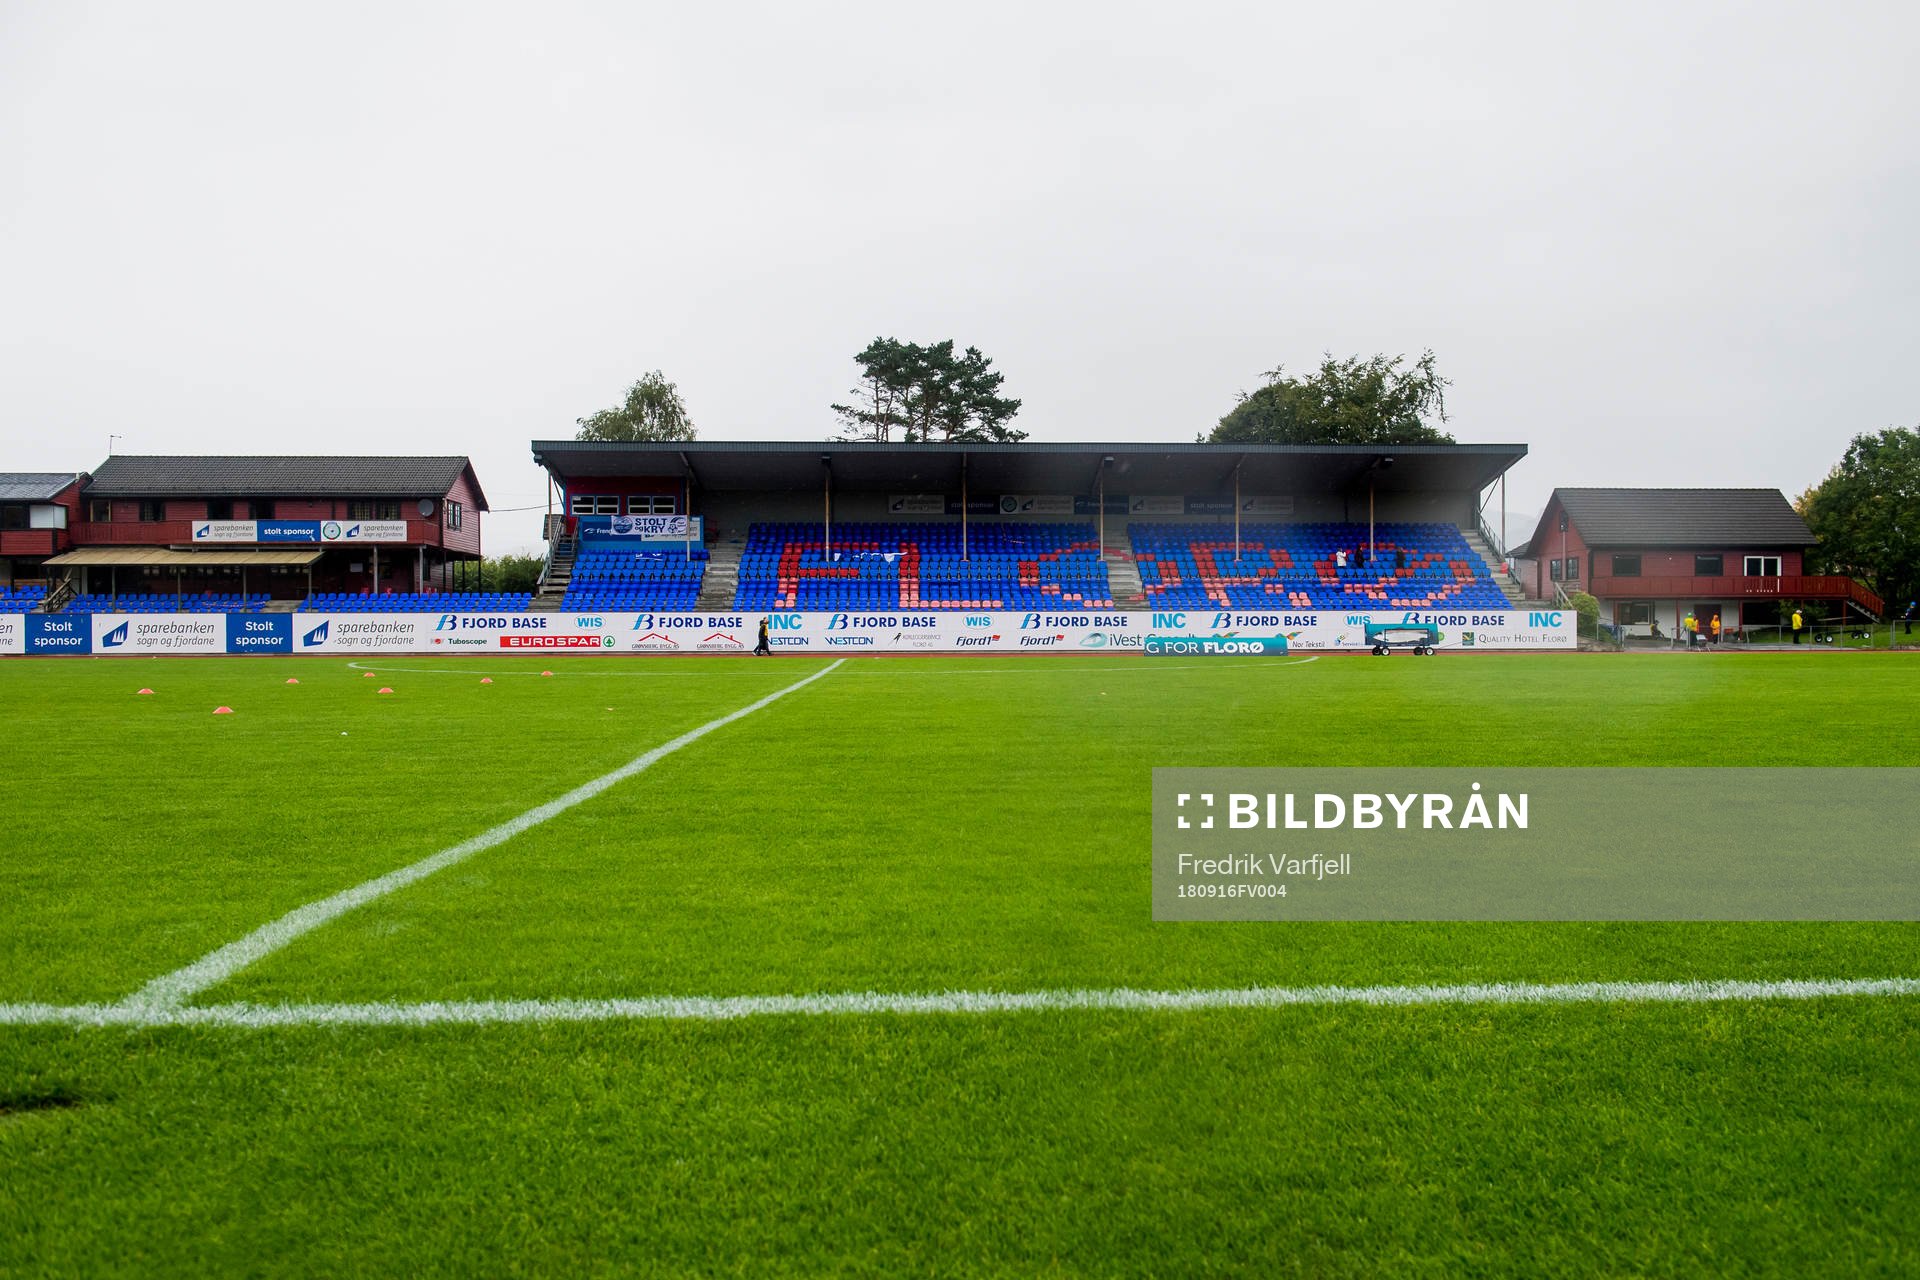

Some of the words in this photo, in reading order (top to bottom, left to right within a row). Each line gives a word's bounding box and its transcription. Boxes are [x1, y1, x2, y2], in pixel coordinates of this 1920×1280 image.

[635, 518, 667, 526] STOLT
[213, 524, 254, 532] sparebanken
[264, 527, 281, 535] stolt
[283, 528, 315, 536] sponsor
[363, 524, 404, 532] sparebanken
[643, 525, 665, 533] KRY
[462, 617, 507, 629] FJORD
[512, 617, 547, 629] BASE
[577, 617, 603, 628] WIS
[659, 616, 703, 628] FJORD
[708, 616, 743, 628] BASE
[768, 613, 802, 630] INC
[853, 616, 898, 628] FJORD
[902, 616, 936, 628] BASE
[965, 616, 991, 627] WIS
[1045, 616, 1090, 627] FJORD
[1094, 616, 1128, 627] BASE
[1152, 612, 1186, 629] INC
[1236, 615, 1279, 627] FJORD
[1284, 615, 1317, 626] BASE
[1346, 615, 1371, 625] WIS
[1424, 615, 1467, 626] FJORD
[1471, 615, 1505, 626] BASE
[1529, 612, 1563, 628] INC
[44, 621, 73, 632] Stolt
[136, 621, 215, 635] sparebanken
[245, 621, 274, 631] Stolt
[336, 621, 415, 635] sparebanken
[34, 637, 83, 647] sponsor
[136, 637, 158, 648] sogn
[160, 637, 172, 648] og
[173, 635, 215, 648] fjordane
[235, 636, 284, 647] sponsor
[337, 637, 359, 647] sogn
[360, 637, 372, 647] og
[374, 635, 415, 647] fjordane
[448, 638, 488, 646] Tuboscope
[510, 637, 600, 646] EUROSPAR
[825, 636, 874, 646] WESTCON
[956, 636, 992, 647] Fjord1
[1020, 635, 1056, 647] Fjord1
[1109, 633, 1142, 647] iVest
[1305, 640, 1326, 648] Tekstil
[1145, 641, 1160, 654] G
[1165, 641, 1200, 654] FOR
[1203, 641, 1265, 654] FLORØ
